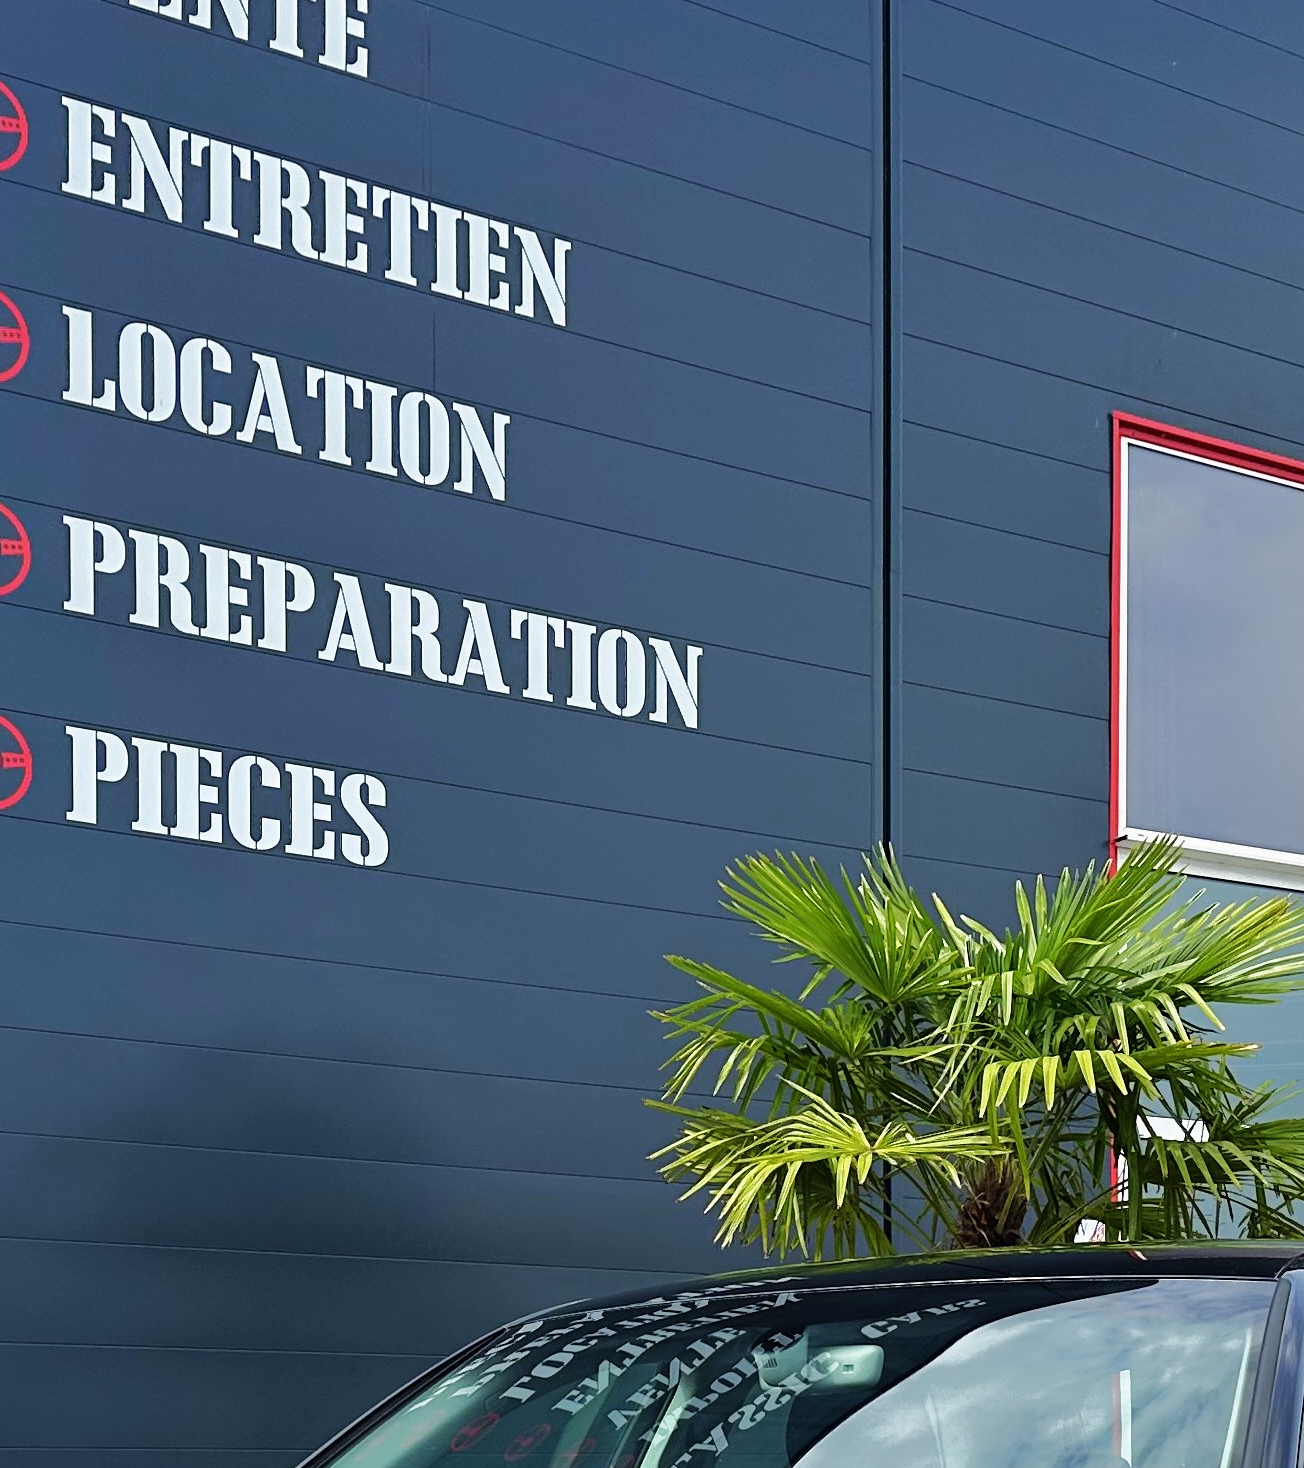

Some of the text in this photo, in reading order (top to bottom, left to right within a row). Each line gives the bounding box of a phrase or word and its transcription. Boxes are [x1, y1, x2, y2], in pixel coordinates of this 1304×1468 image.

[61, 95, 572, 328] ENTRETIEN
[61, 304, 511, 502] LOCATION
[62, 514, 703, 730] PREPARATION
[64, 725, 390, 867] PIECES
